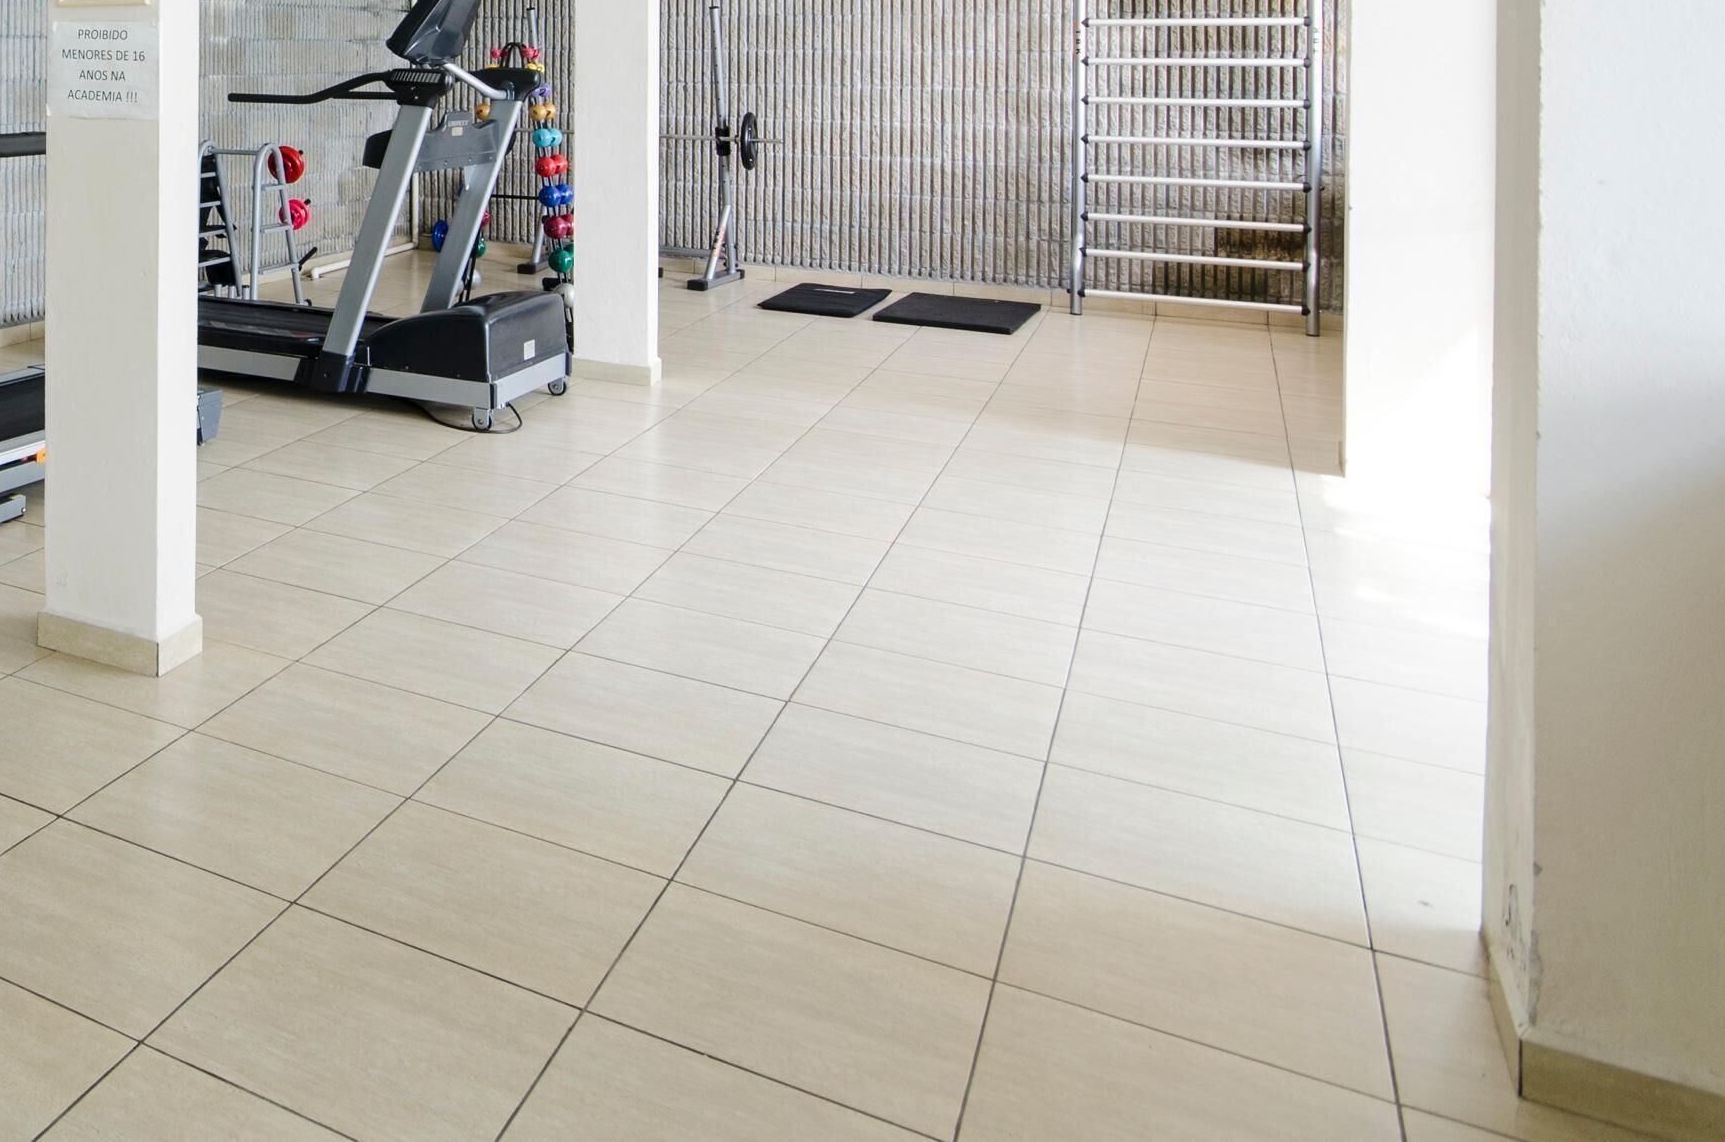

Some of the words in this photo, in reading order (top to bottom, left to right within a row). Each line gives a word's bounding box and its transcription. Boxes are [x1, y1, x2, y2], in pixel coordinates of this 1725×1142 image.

[77, 29, 128, 40] PROIBIDO
[61, 49, 113, 61] MENORES
[116, 50, 129, 61] DE
[132, 51, 146, 62] 16
[78, 70, 108, 81] ANOS
[110, 71, 126, 81] NA
[67, 90, 123, 102] ACADEMIA
[125, 92, 139, 103] !!!
